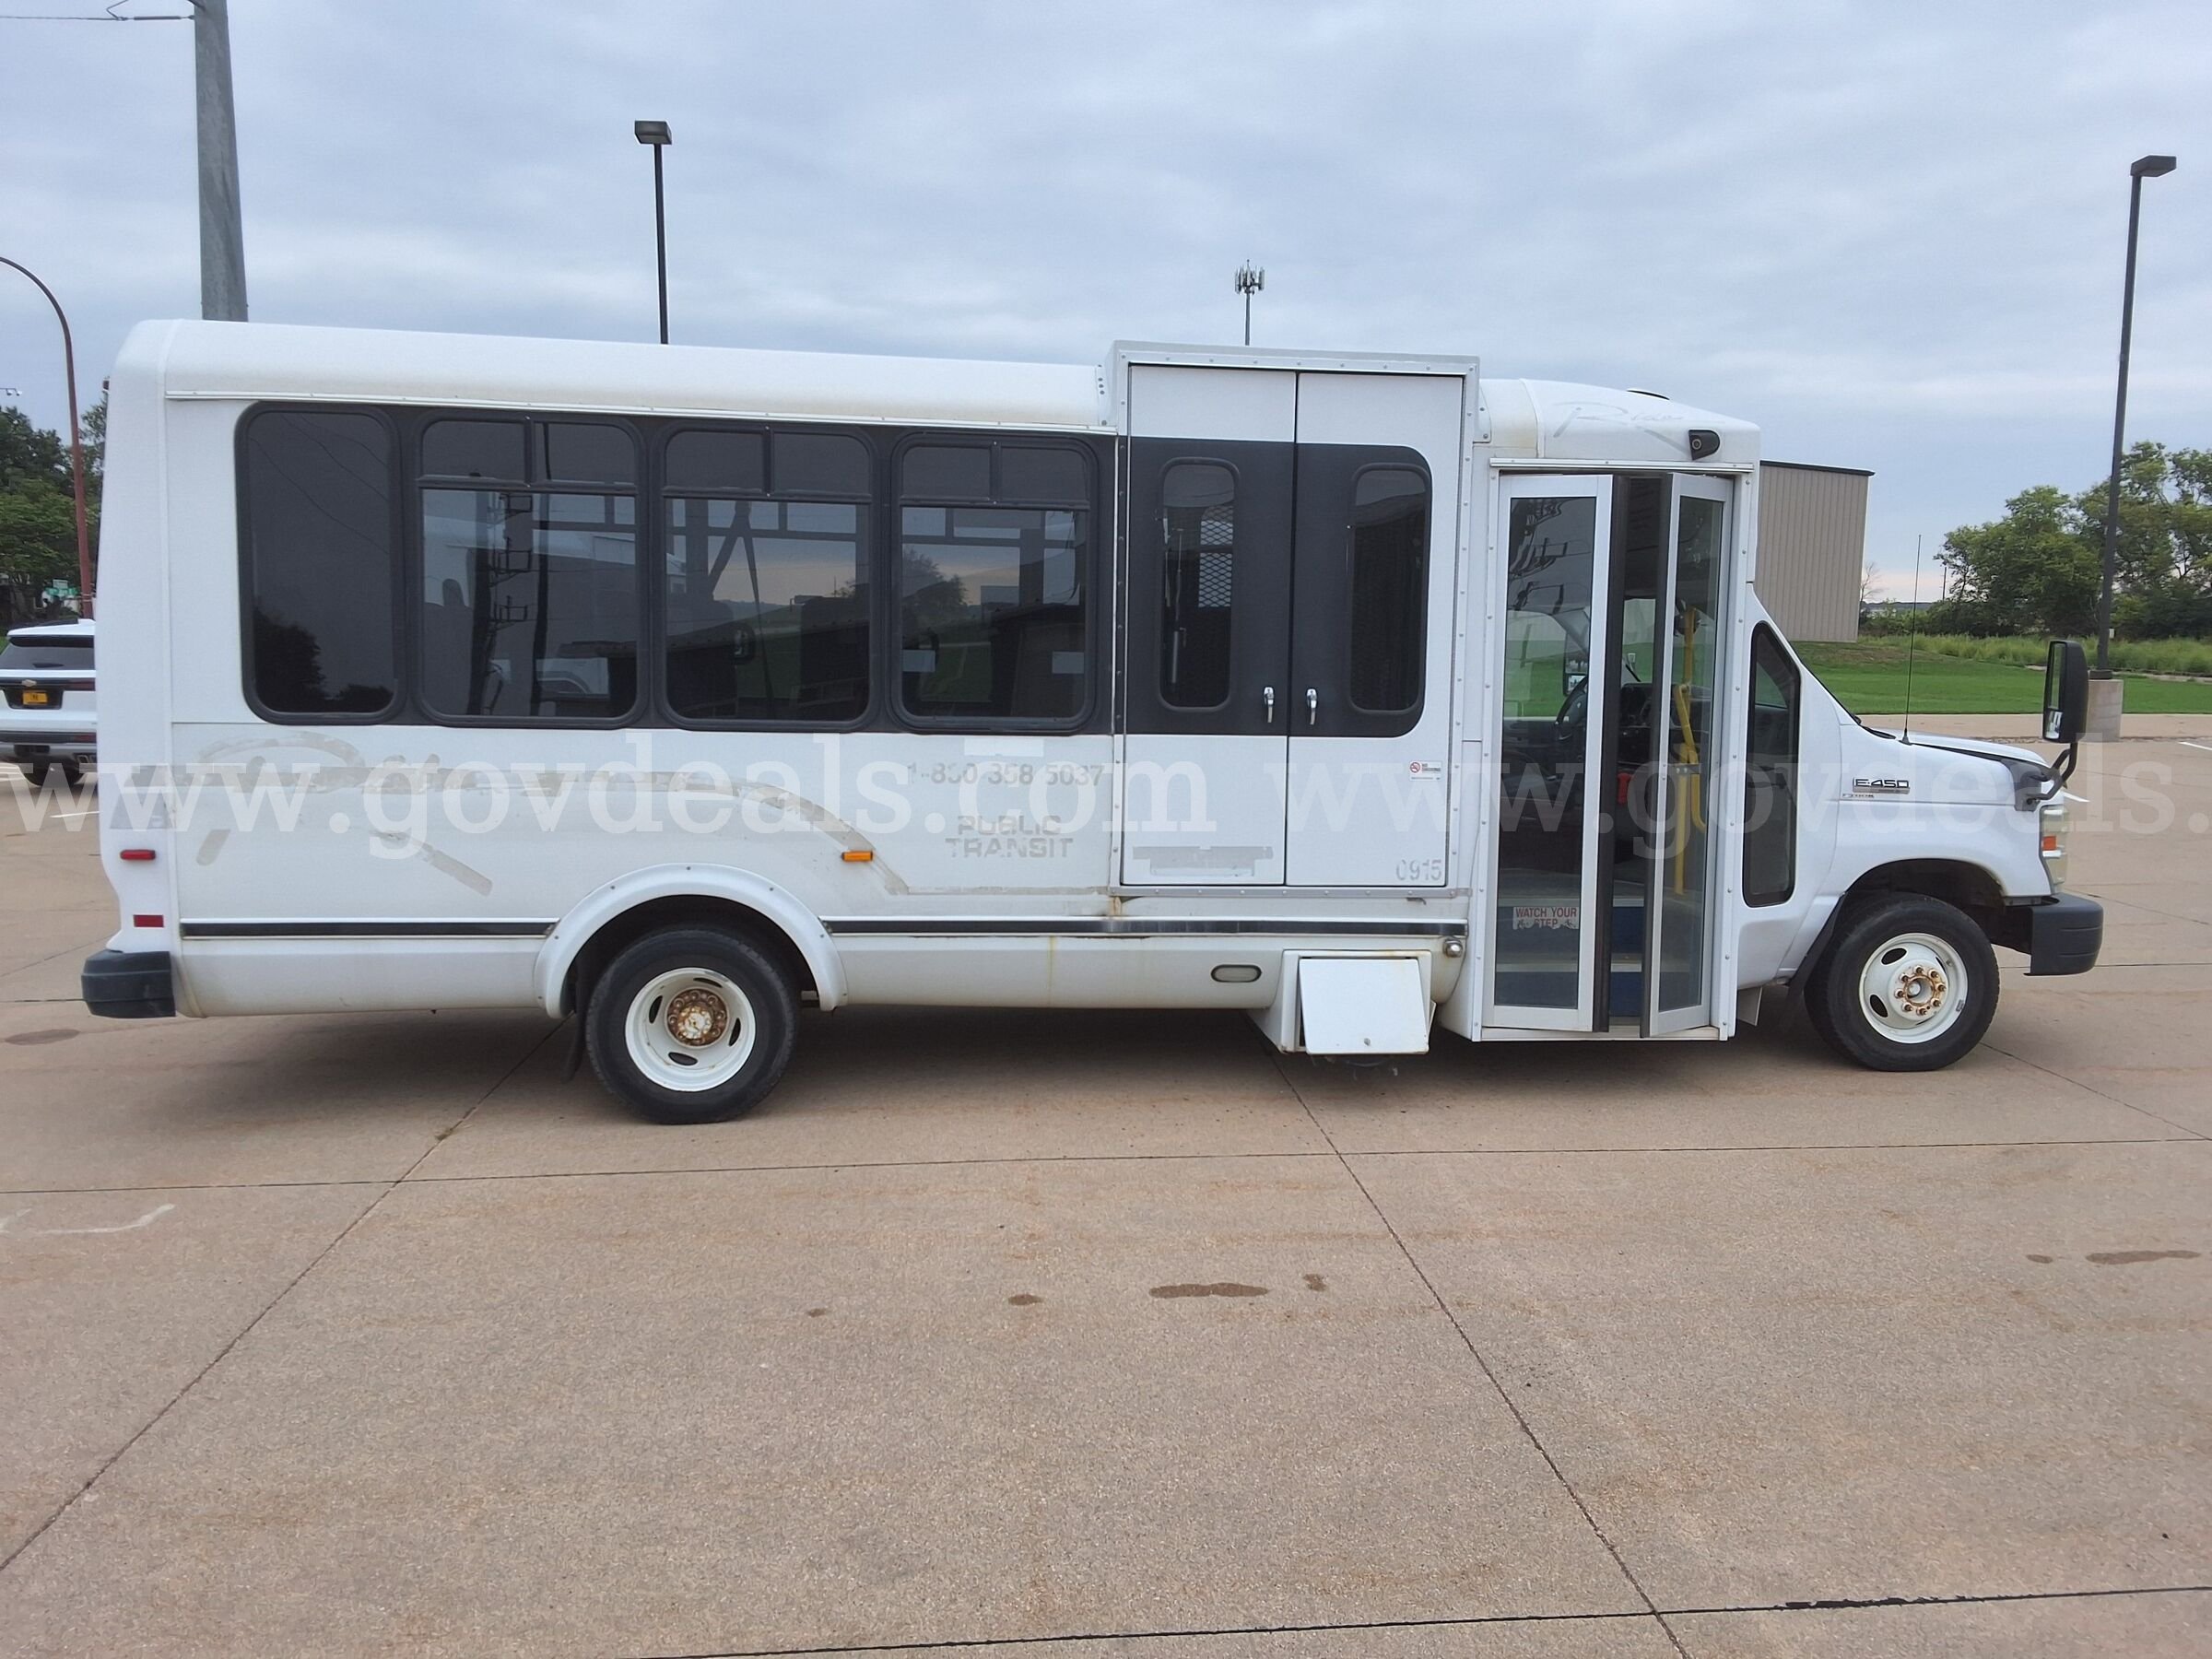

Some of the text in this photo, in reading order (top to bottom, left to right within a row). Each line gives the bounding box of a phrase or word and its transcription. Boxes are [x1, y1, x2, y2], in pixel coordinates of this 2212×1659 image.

[958, 815, 1062, 835] PUBLIC
[945, 838, 1074, 858] TRANSIT
[1395, 859, 1442, 881] 0915
[1515, 907, 1577, 918] WATCH YOUR
